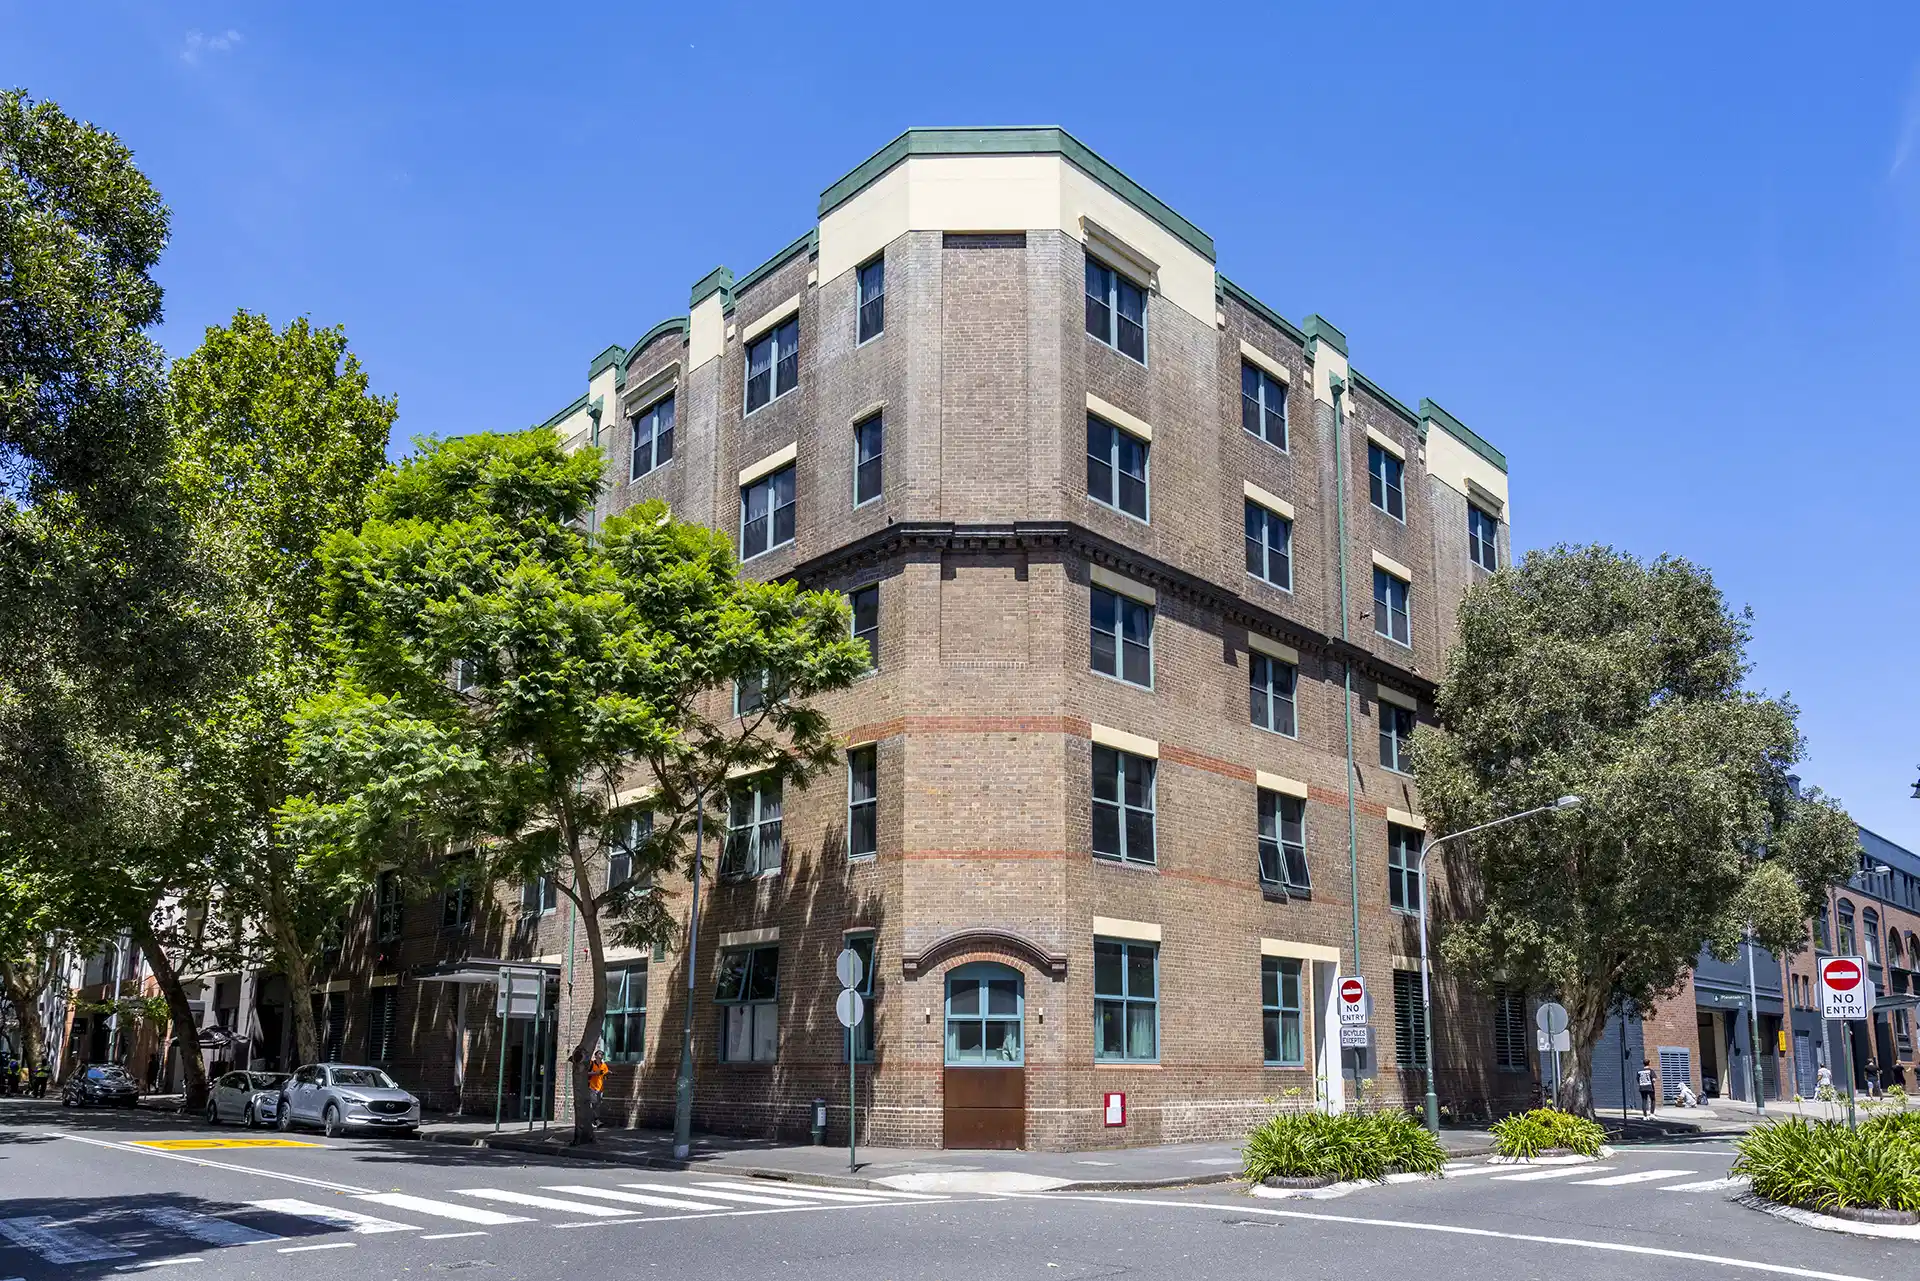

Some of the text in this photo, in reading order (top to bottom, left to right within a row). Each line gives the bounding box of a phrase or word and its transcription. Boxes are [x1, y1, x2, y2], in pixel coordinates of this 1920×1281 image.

[1833, 993, 1854, 1003] NO
[1346, 1004, 1359, 1012] NO
[1826, 1006, 1862, 1014] ENTRY
